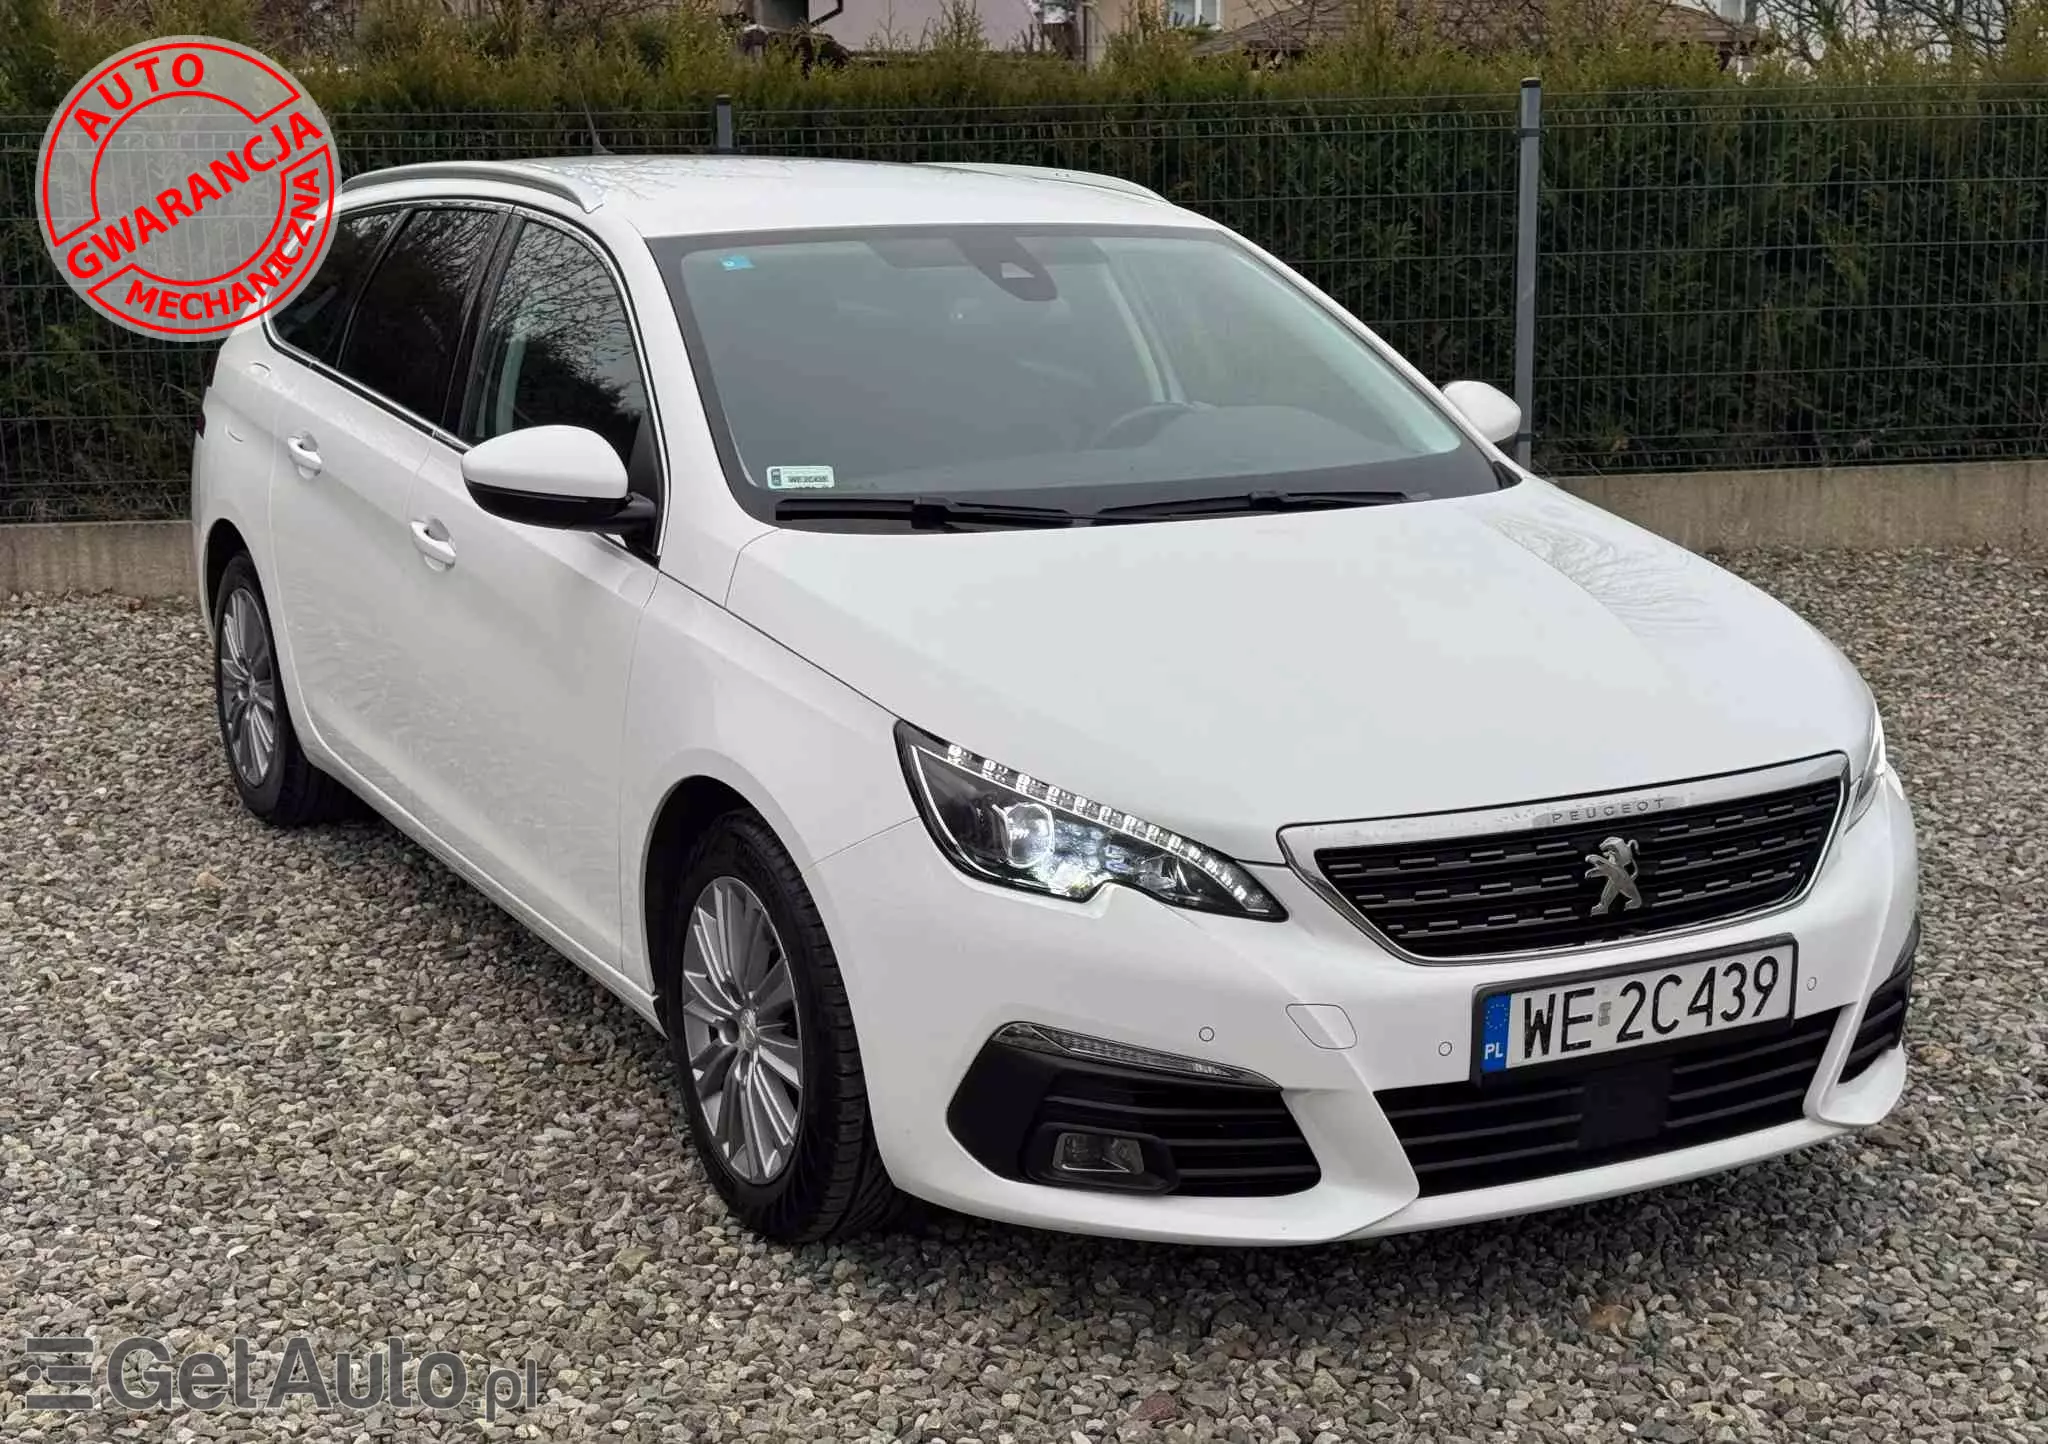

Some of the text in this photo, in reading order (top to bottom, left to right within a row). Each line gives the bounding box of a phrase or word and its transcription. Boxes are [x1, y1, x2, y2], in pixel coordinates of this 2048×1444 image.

[1551, 798, 1665, 824] PEUGEOT
[1523, 955, 1780, 1059] WE 2C439
[1484, 1043, 1504, 1060] PL
